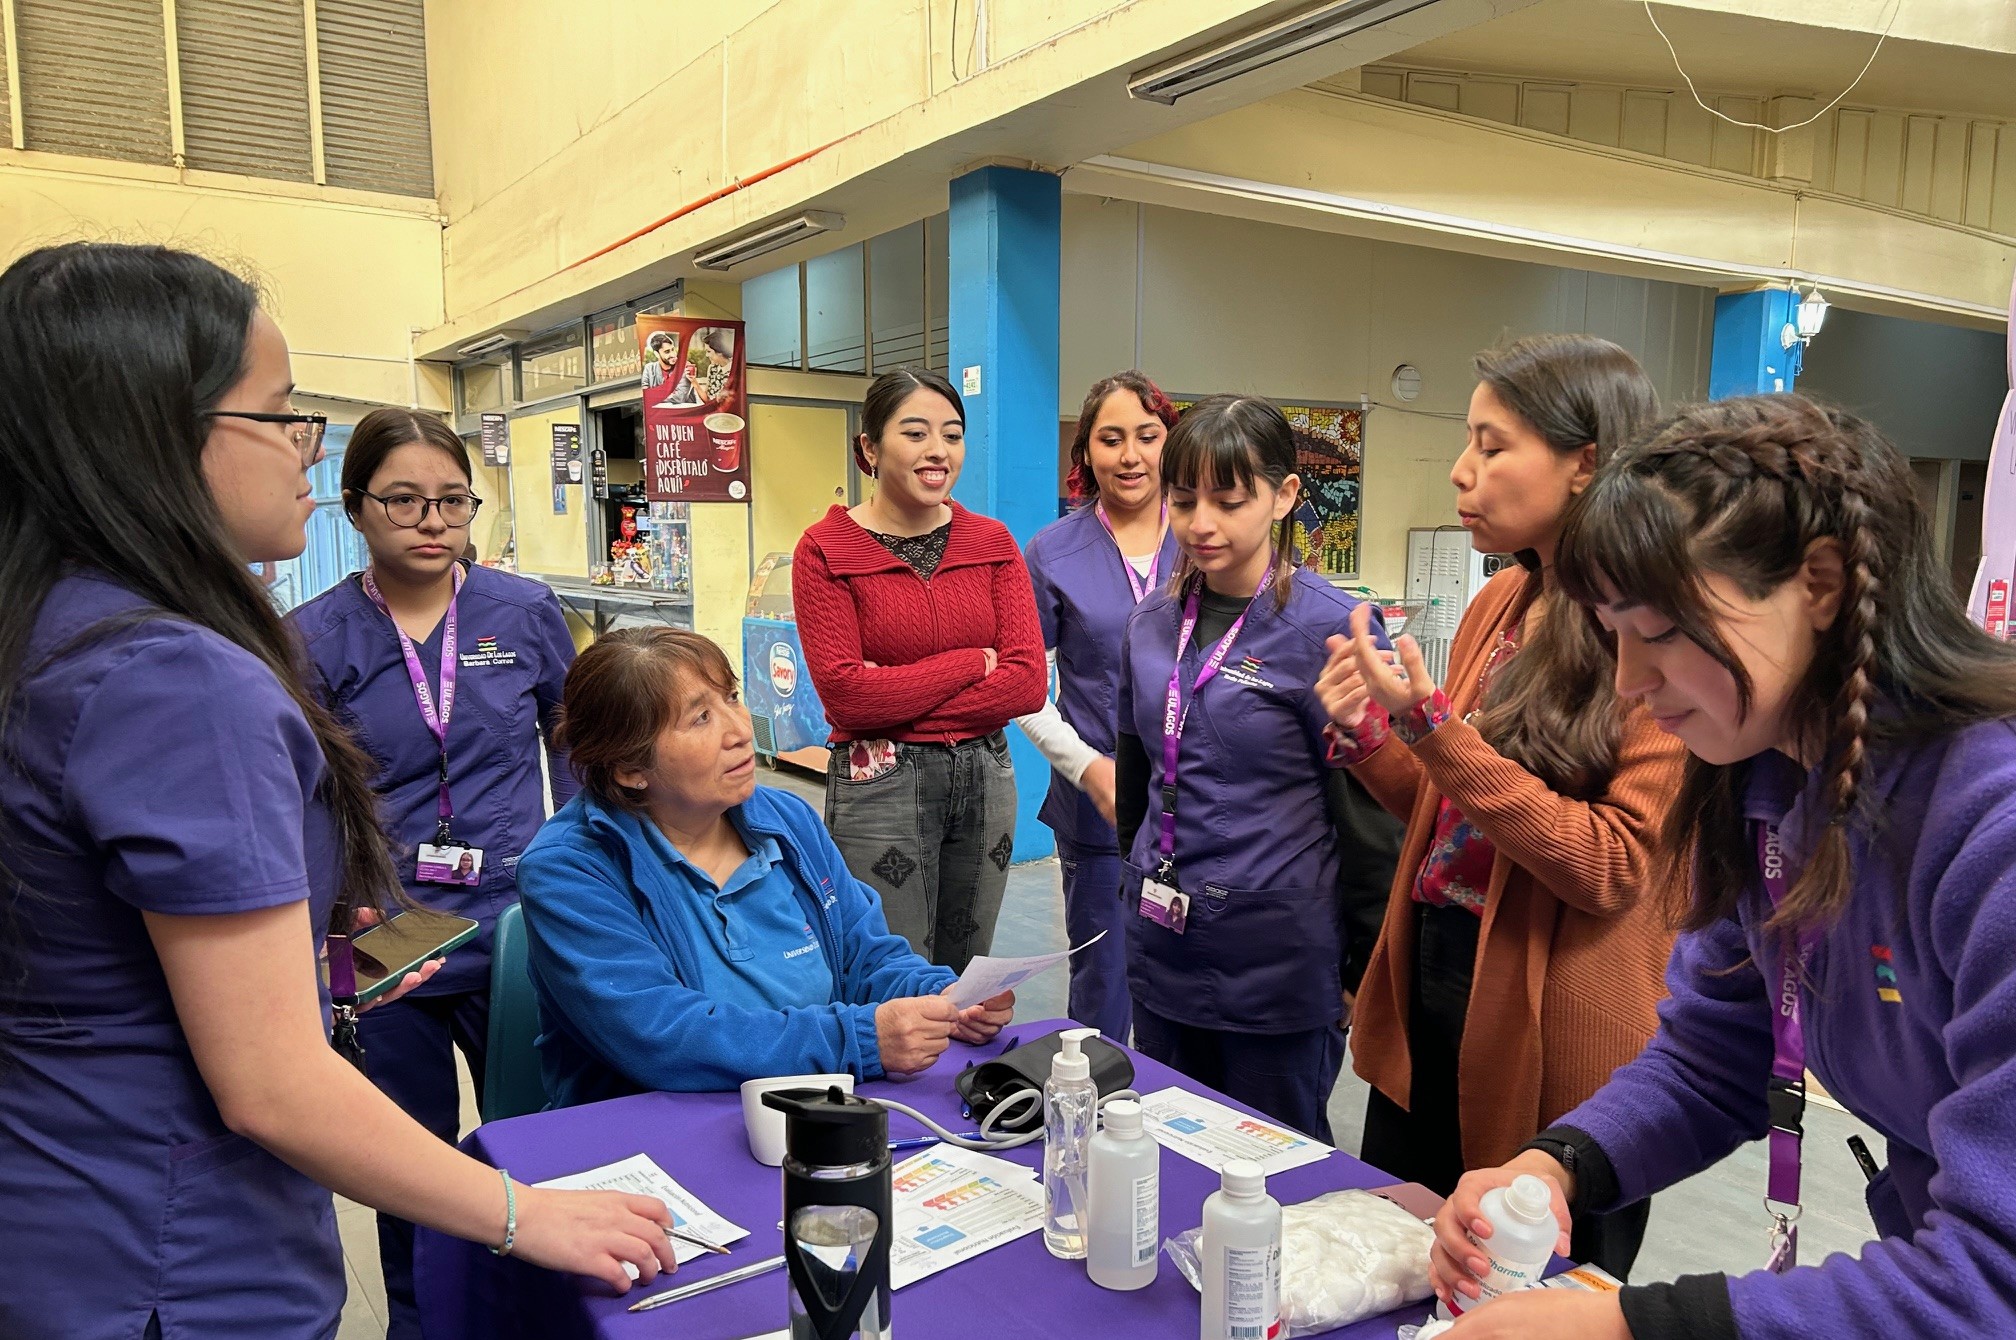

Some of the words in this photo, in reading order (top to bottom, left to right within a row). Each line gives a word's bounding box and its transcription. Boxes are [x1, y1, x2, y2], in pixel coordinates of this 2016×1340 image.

[656, 424, 669, 441] UN
[671, 424, 694, 441] BUEN
[656, 440, 682, 459] CAFÉ
[657, 477, 684, 494] AQUÍ!
[445, 624, 455, 657] ULAGOS
[1213, 627, 1239, 661] ULAGOS
[773, 662, 794, 685] Savory
[416, 682, 434, 716] ULAGOS
[441, 689, 451, 724] ULAGOS
[1165, 699, 1178, 736] ULAGOS
